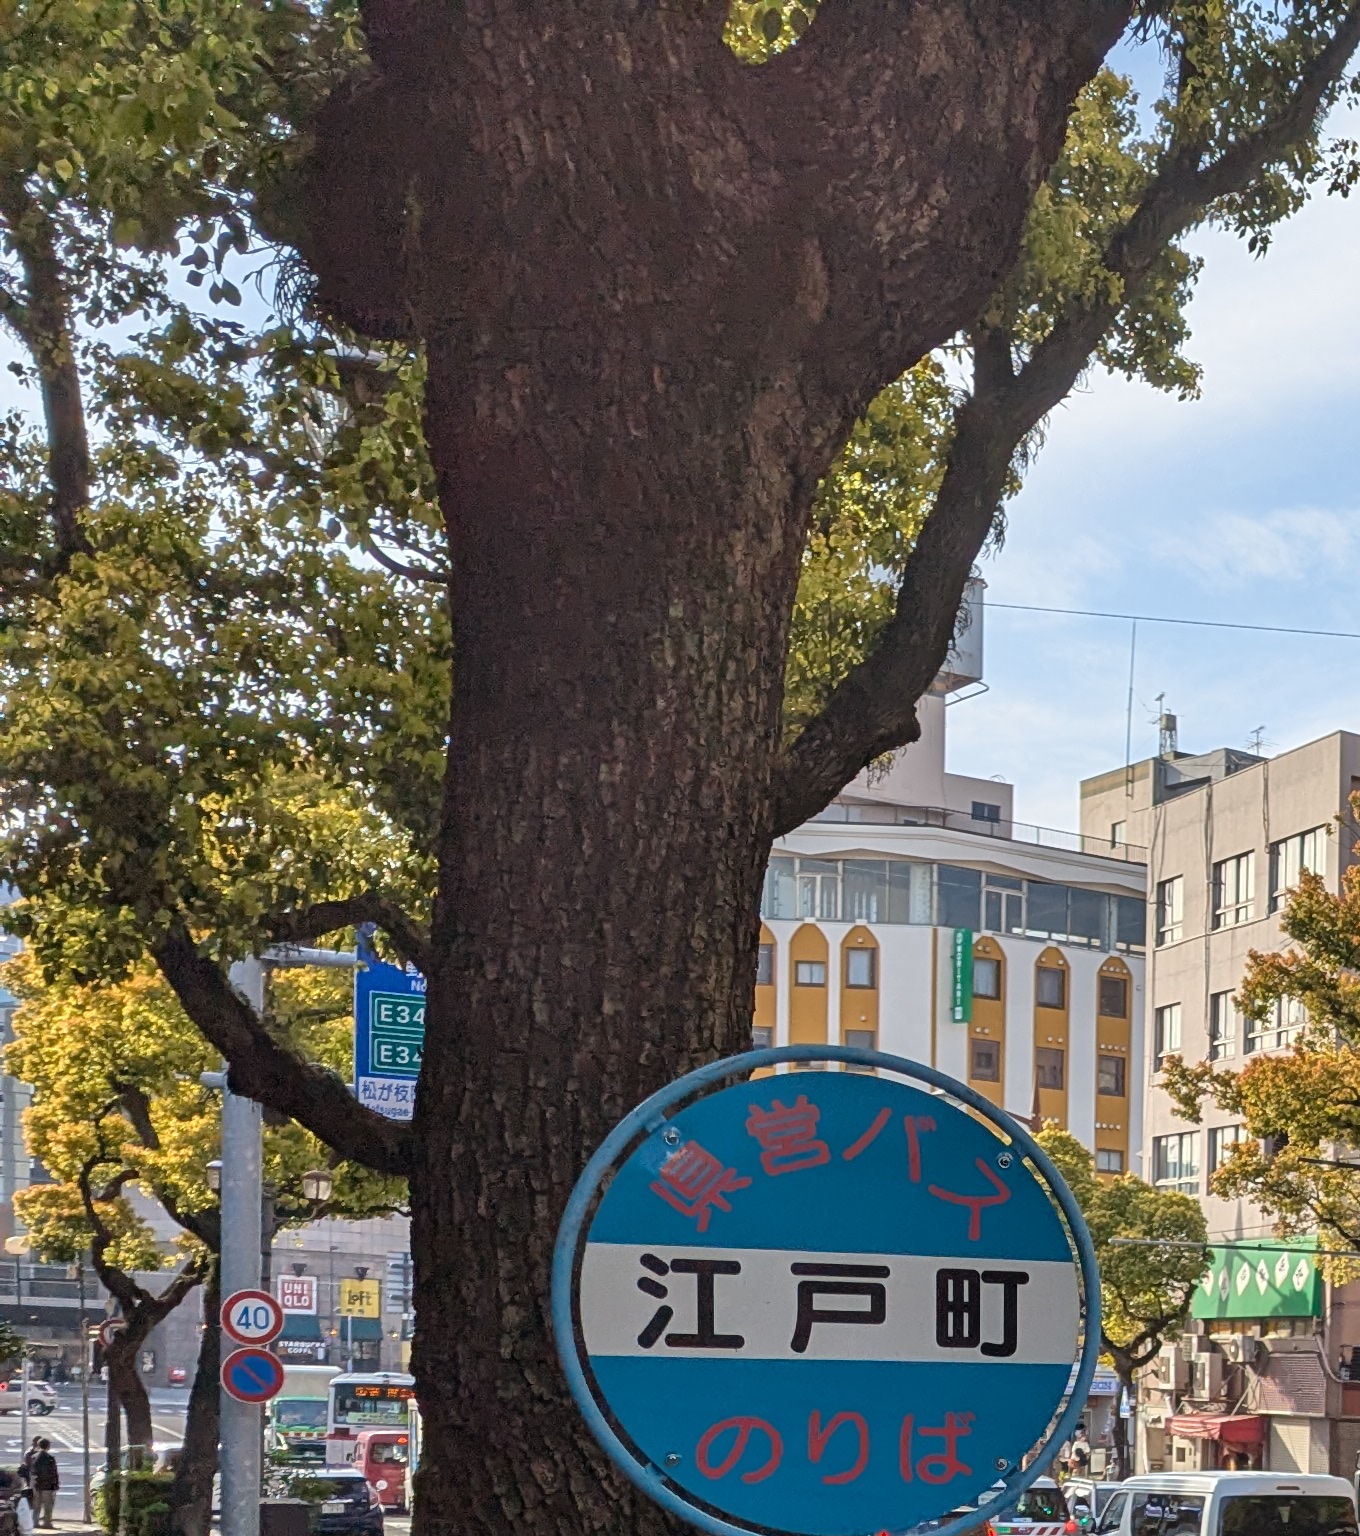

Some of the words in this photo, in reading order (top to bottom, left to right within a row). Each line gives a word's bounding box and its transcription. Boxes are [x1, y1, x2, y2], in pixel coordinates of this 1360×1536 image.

[650, 1095, 1011, 1240] 県営バス
[284, 1283, 309, 1294] UNI
[284, 1295, 309, 1307] QLO
[637, 1253, 1030, 1357] 江戸町
[236, 1306, 270, 1329] 40
[696, 1409, 976, 1485] のりば
